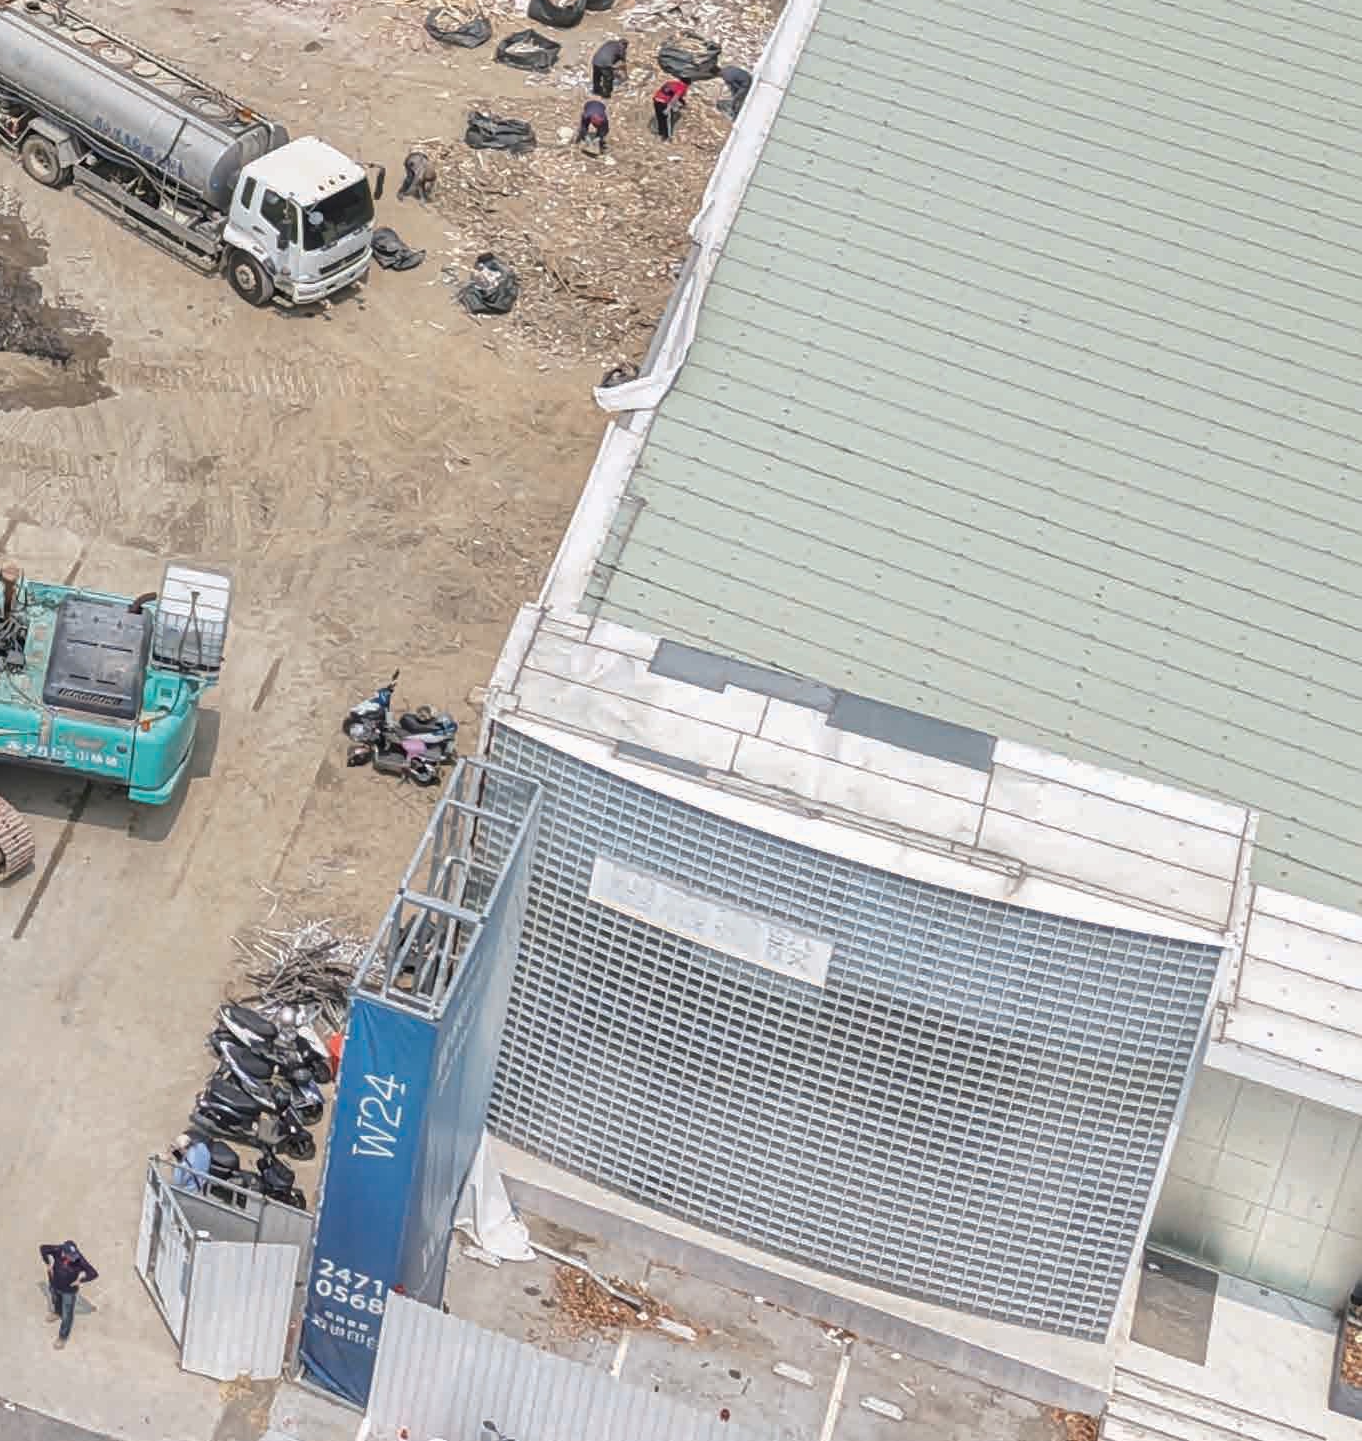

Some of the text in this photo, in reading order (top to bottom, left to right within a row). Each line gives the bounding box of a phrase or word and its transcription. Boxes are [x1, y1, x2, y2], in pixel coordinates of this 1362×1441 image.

[352, 1073, 406, 1158] W24
[317, 1257, 384, 1297] 2471
[315, 1279, 384, 1316] 0568
